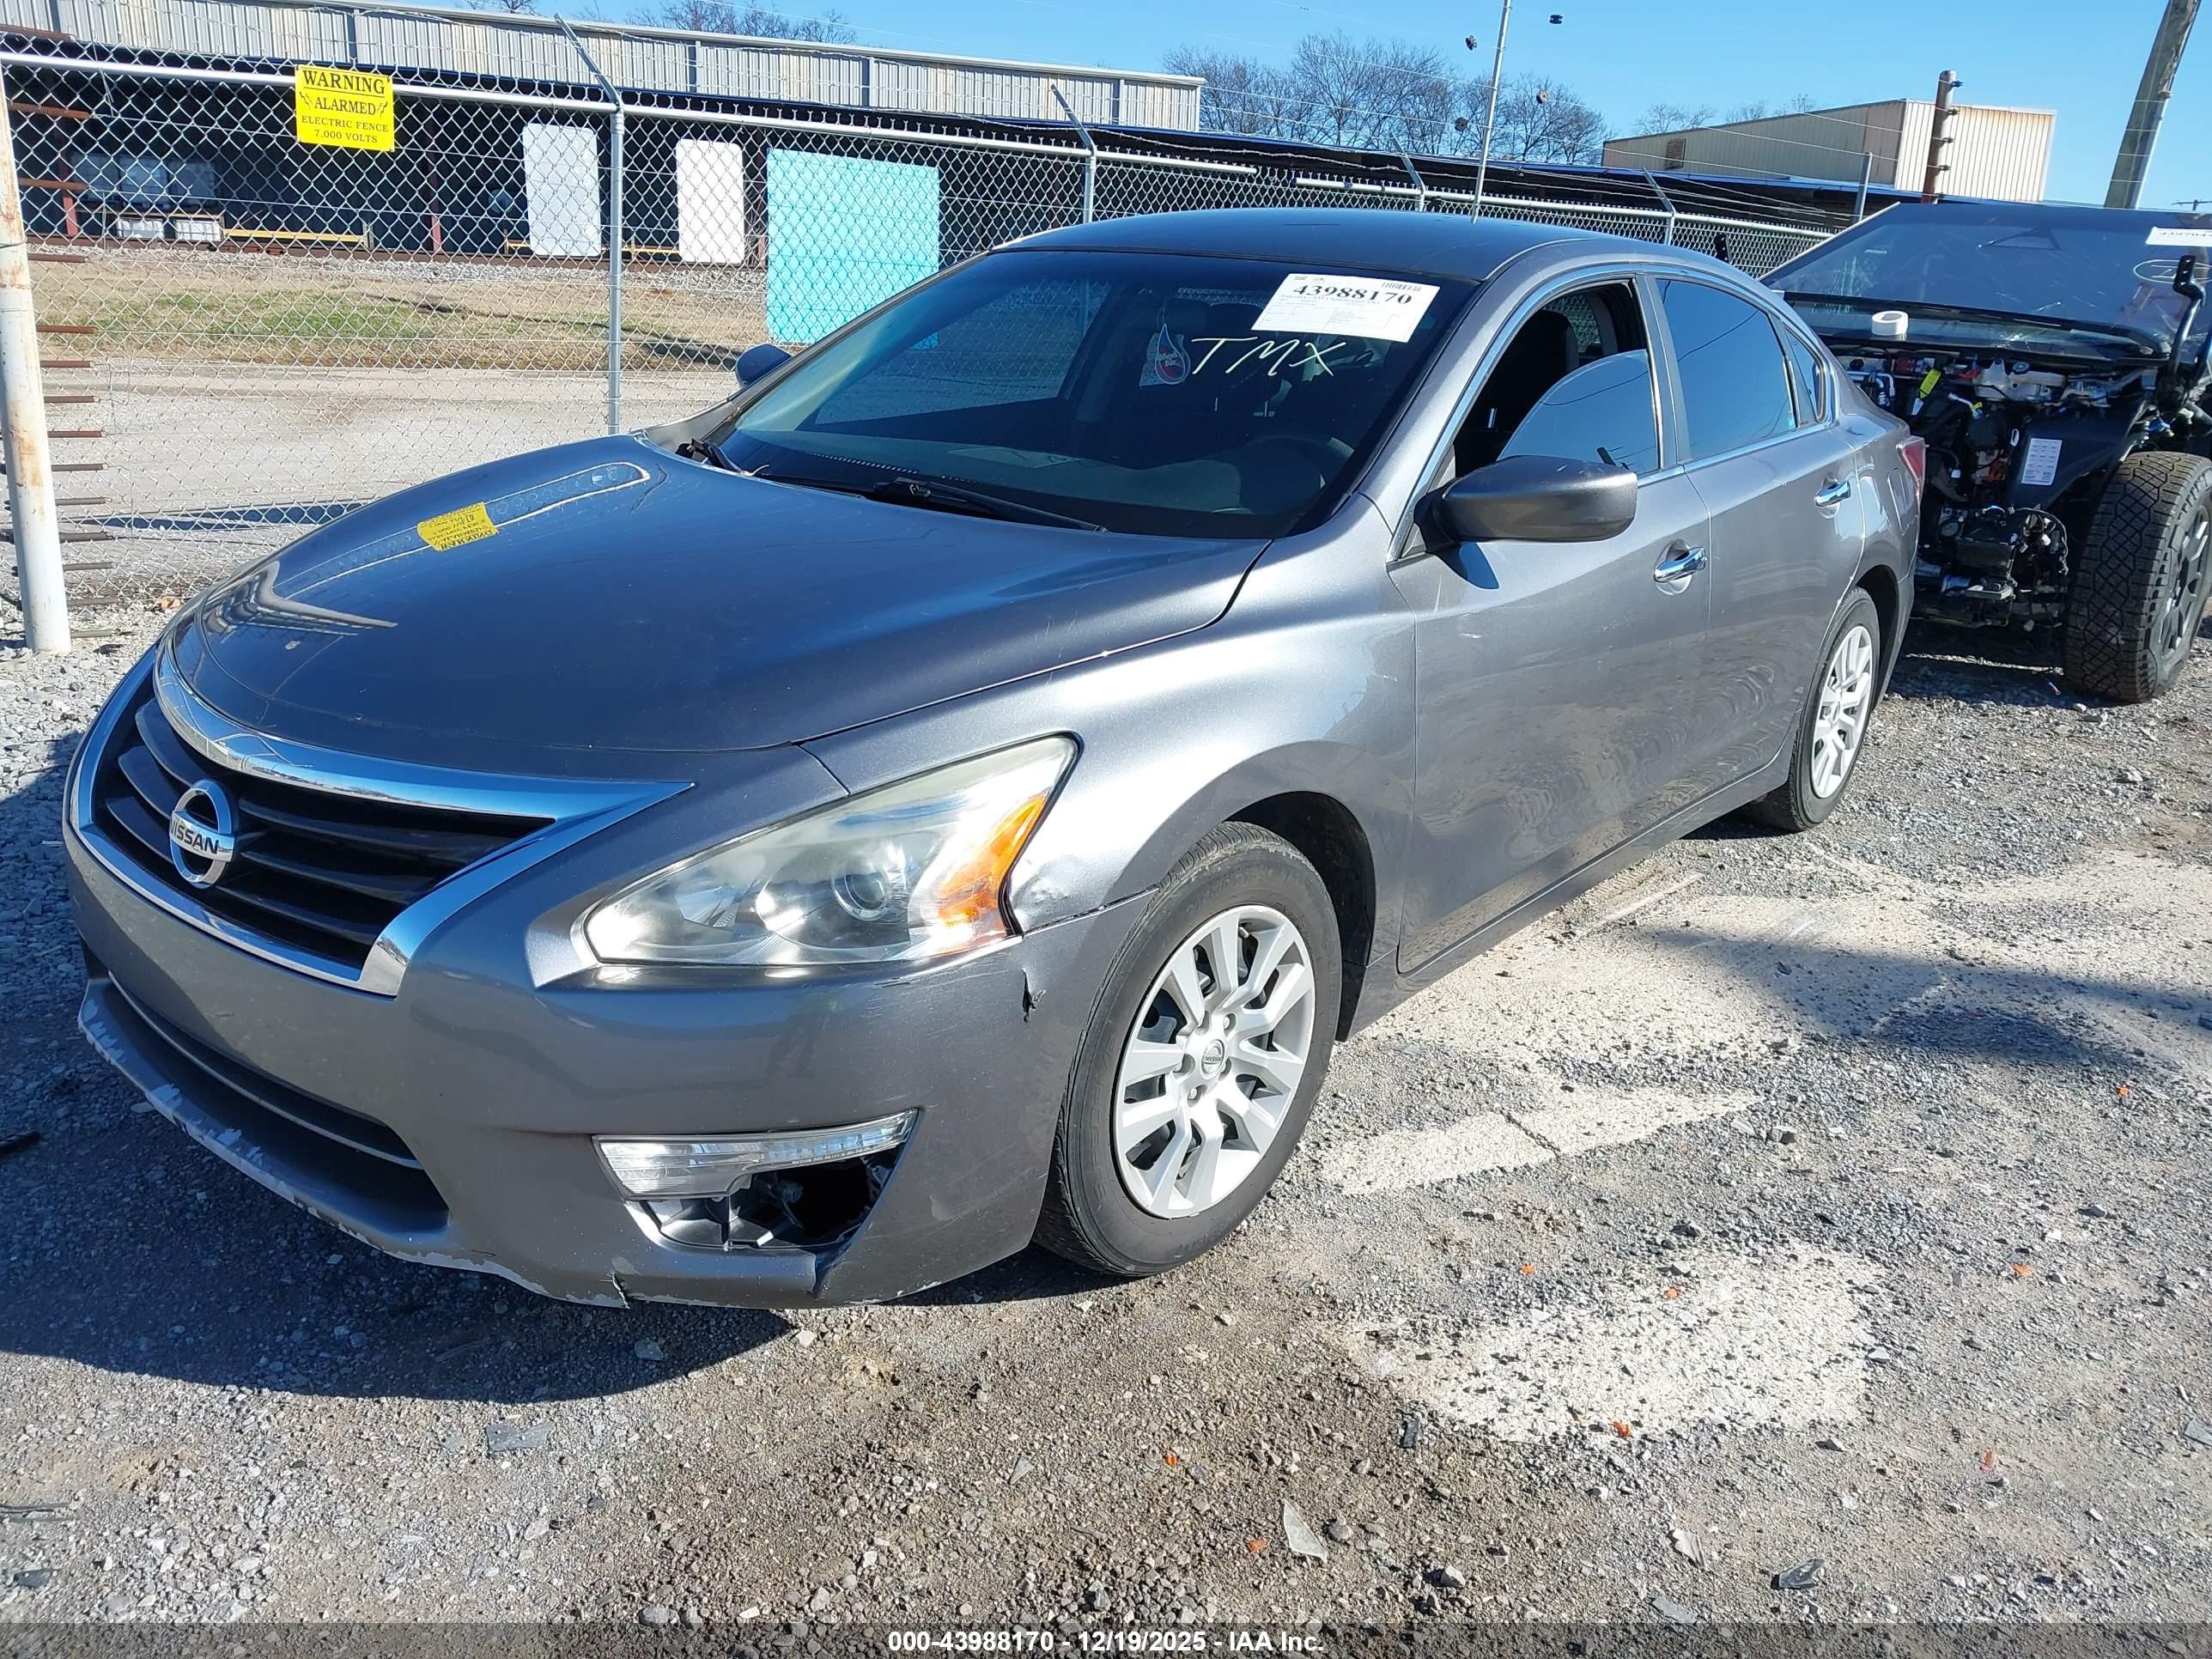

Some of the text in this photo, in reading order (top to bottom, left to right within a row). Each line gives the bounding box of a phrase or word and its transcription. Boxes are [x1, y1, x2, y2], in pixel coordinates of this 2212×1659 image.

[302, 70, 386, 95] WARNING
[314, 96, 376, 115] ALARMED
[301, 115, 389, 132] ELECTRIC FENCE
[345, 133, 378, 143] VOLTS
[1293, 284, 1413, 305] 43988170
[1191, 336, 1347, 377] TMX
